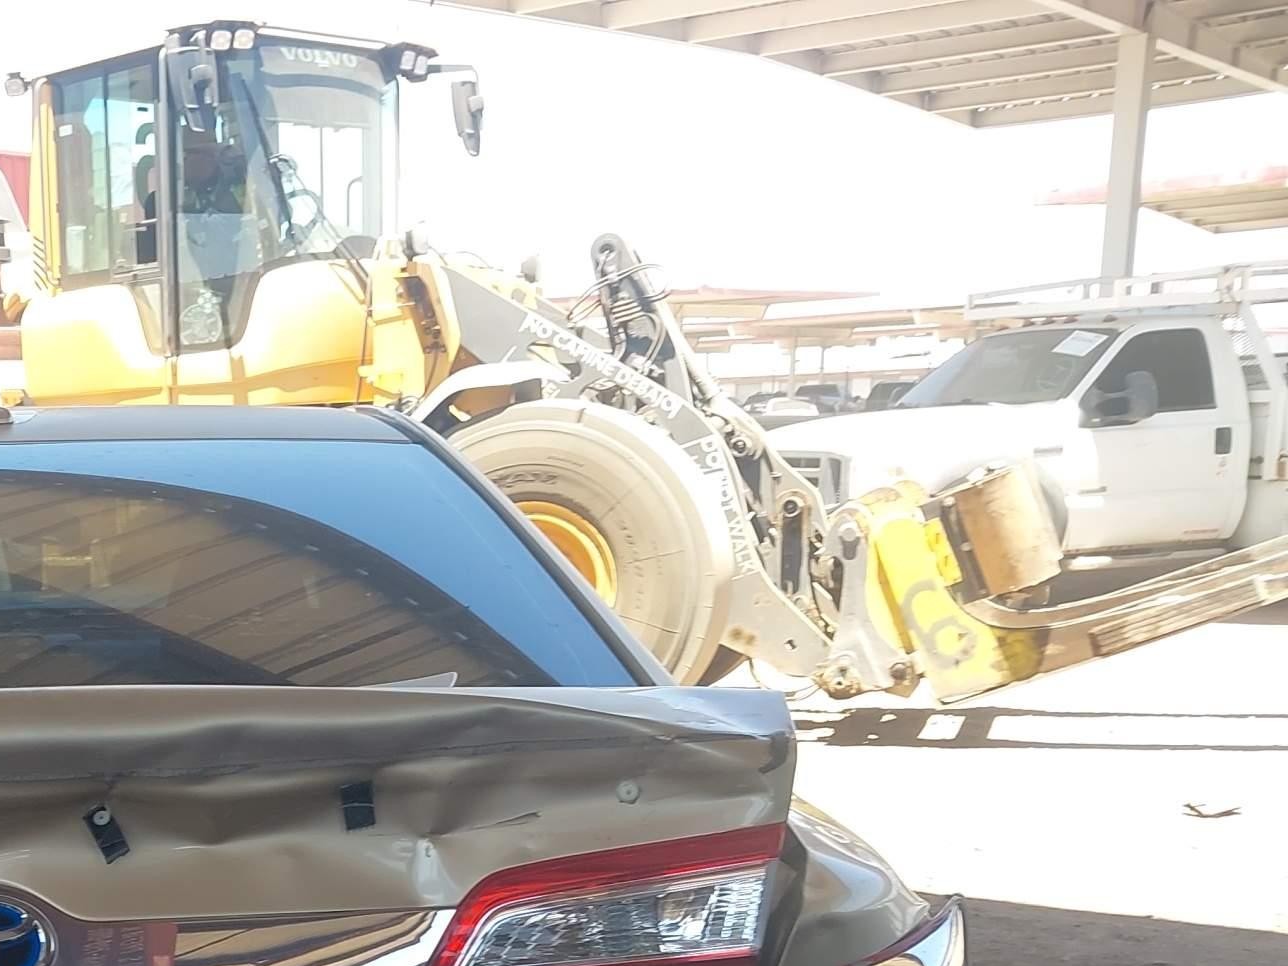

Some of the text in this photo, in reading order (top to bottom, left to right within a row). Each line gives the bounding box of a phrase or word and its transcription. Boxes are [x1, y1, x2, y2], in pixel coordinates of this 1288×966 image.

[280, 47, 358, 68] VOLVO
[522, 313, 679, 413] NO CAMINE DEBAJO
[728, 513, 757, 573] WALK
